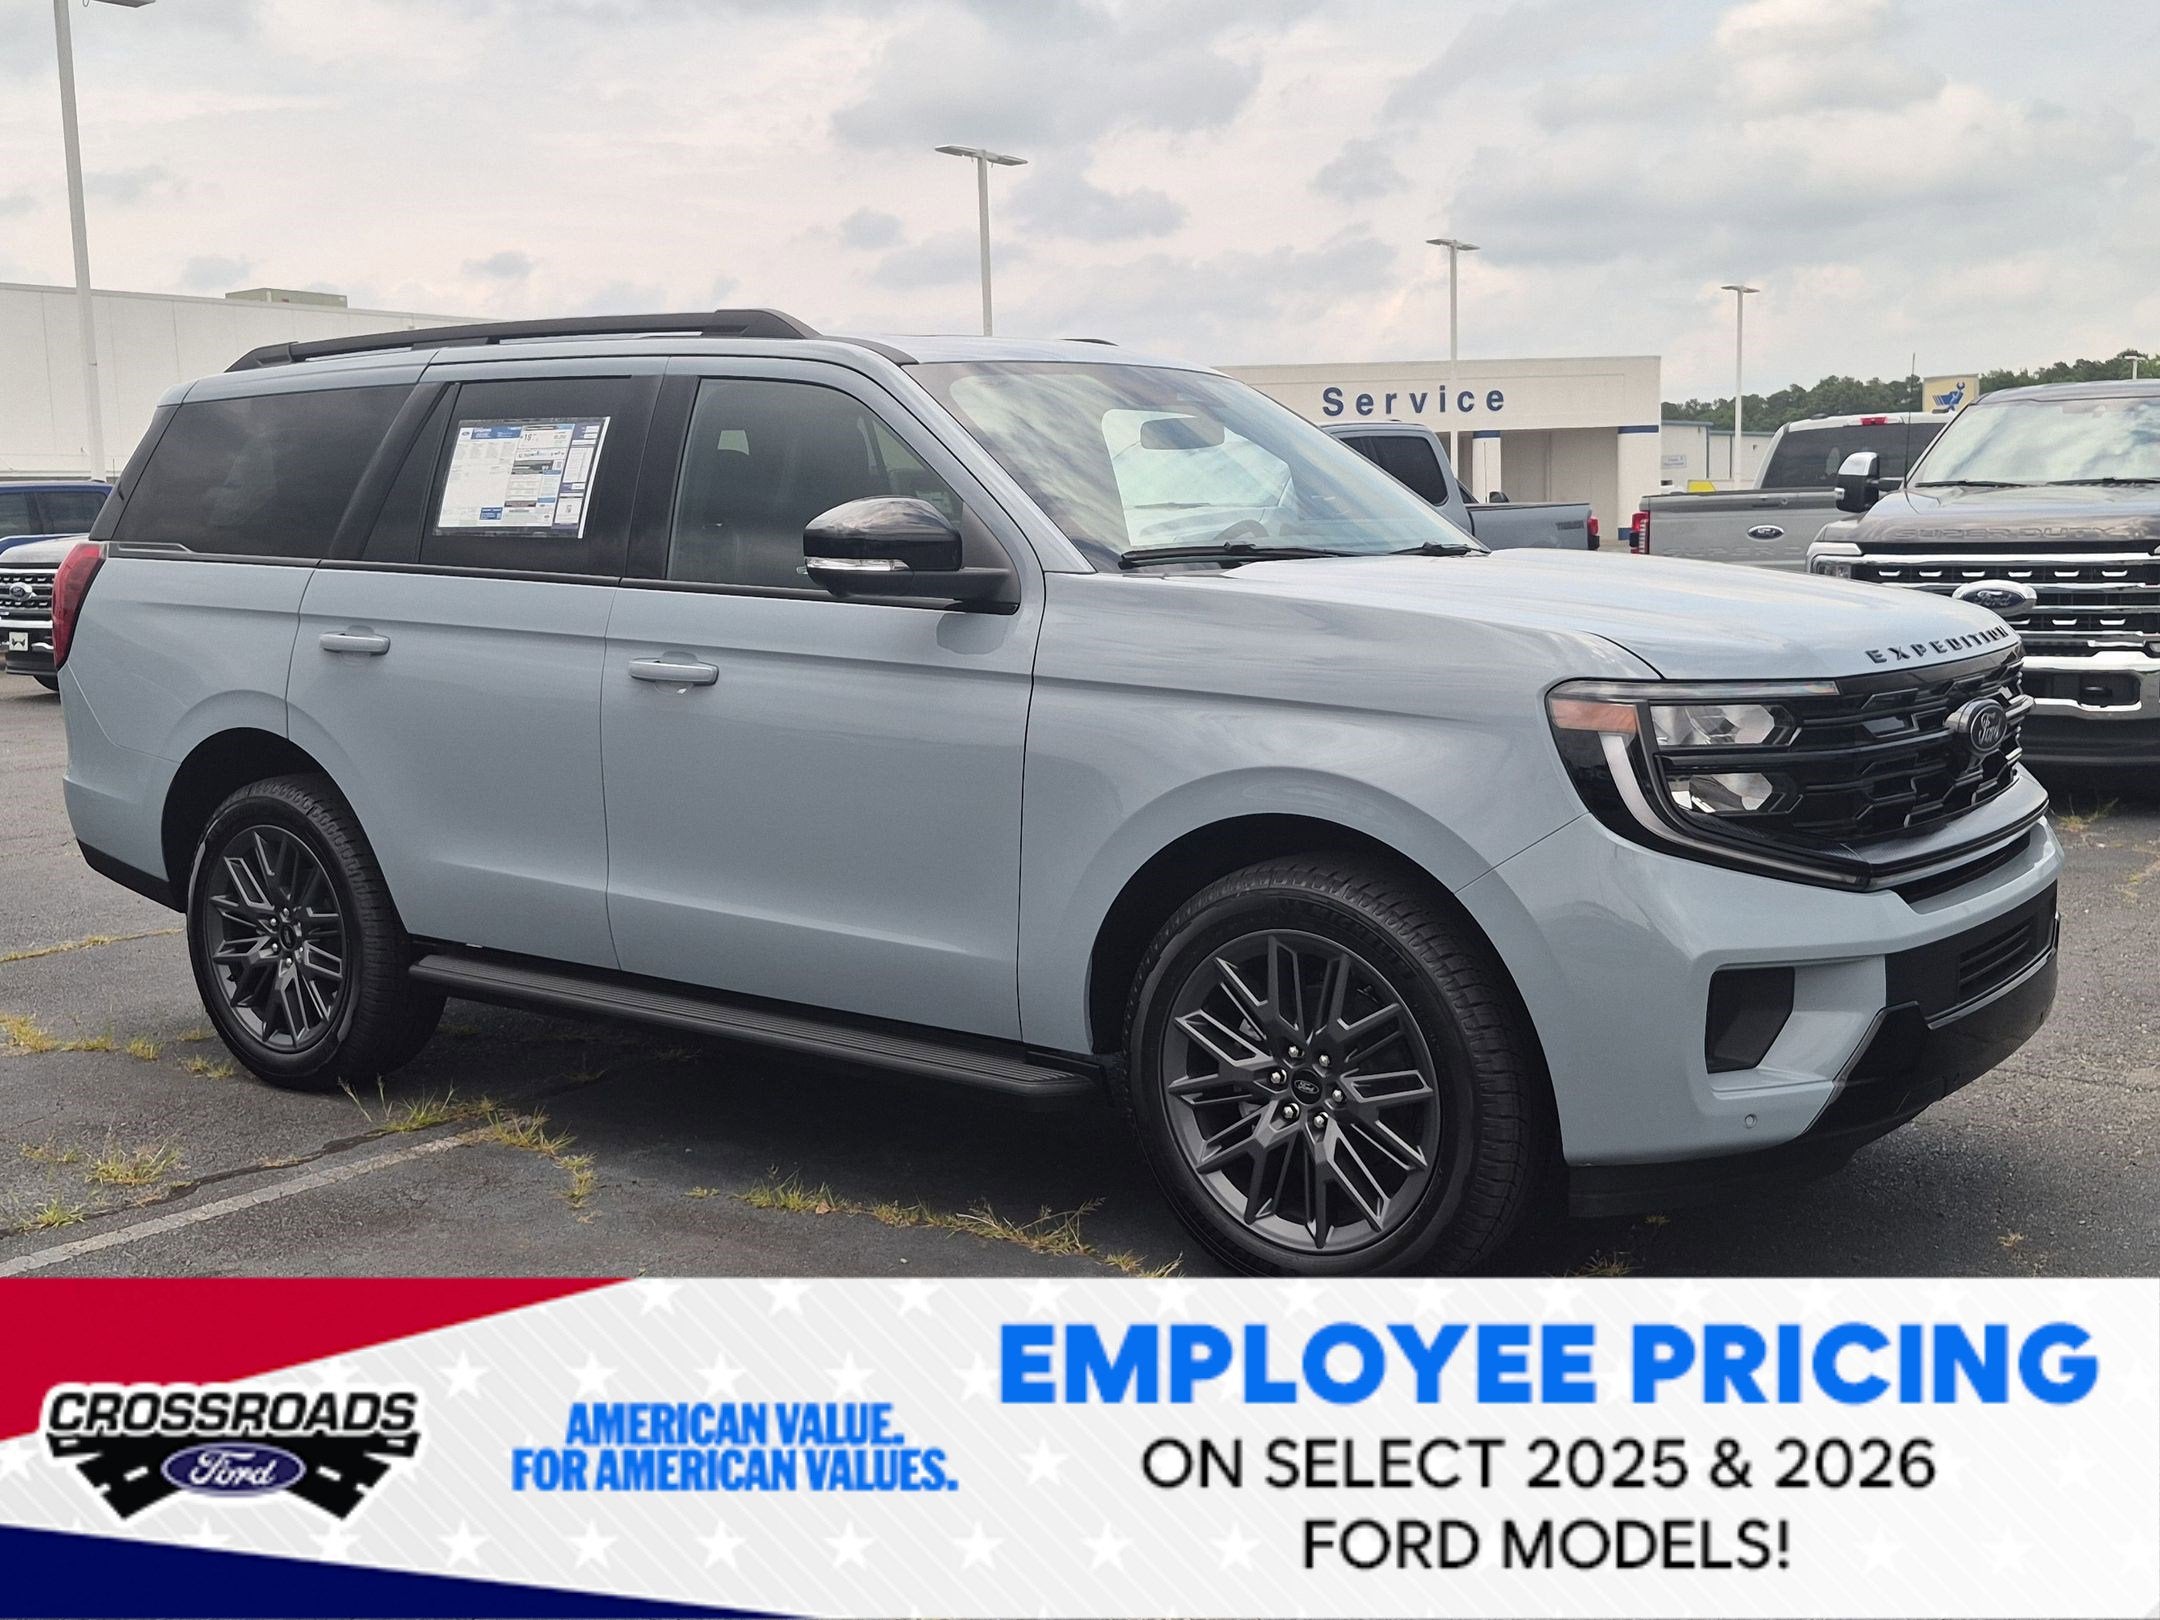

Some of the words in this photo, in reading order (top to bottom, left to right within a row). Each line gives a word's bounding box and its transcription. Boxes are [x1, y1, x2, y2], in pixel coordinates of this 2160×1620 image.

[1322, 385, 1505, 417] Service
[1895, 526, 2011, 540] SUPER
[2018, 526, 2117, 540] DUTY
[1864, 625, 2010, 664] EXPEDITION
